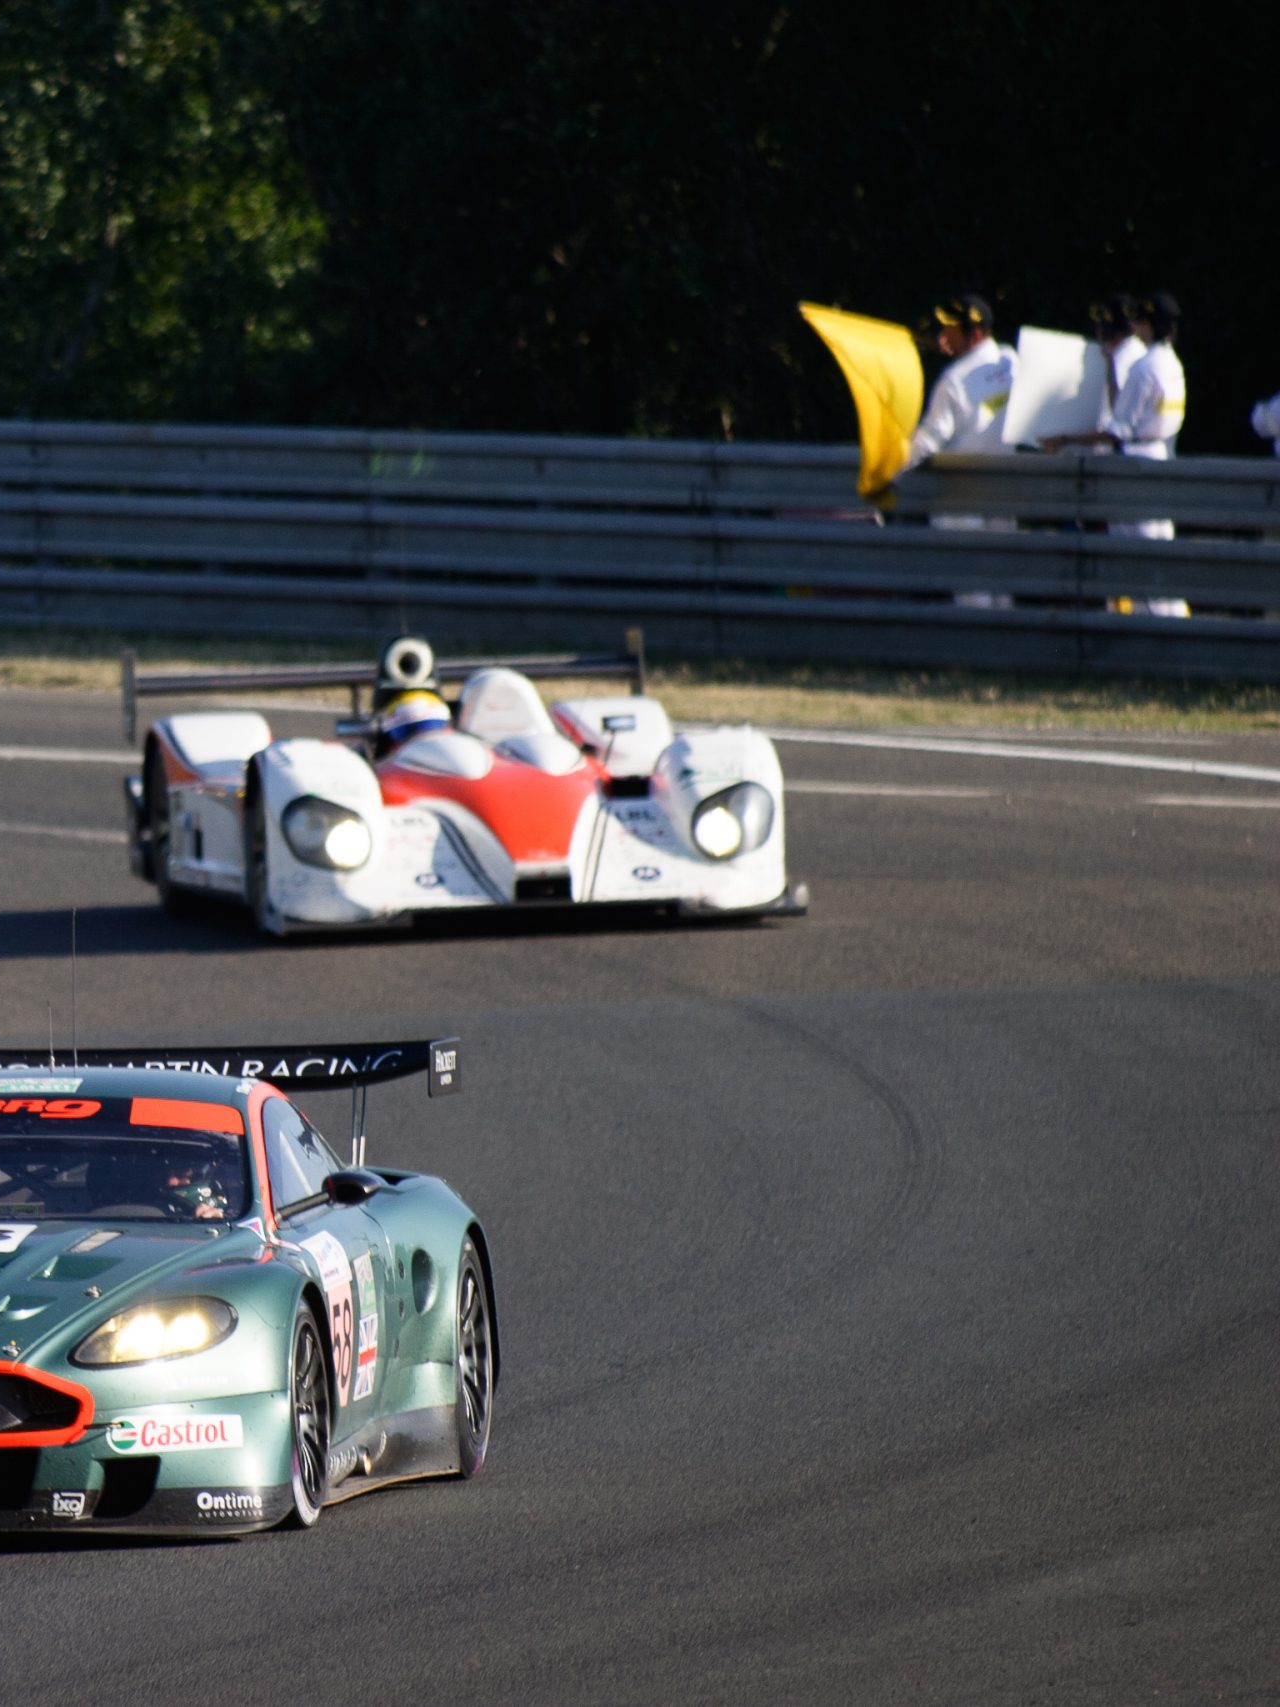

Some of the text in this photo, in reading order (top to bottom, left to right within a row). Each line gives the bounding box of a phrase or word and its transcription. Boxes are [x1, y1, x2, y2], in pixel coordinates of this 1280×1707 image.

[332, 1298, 352, 1389] 58
[140, 1419, 230, 1448] Castrol
[196, 1491, 263, 1511] Ontime
